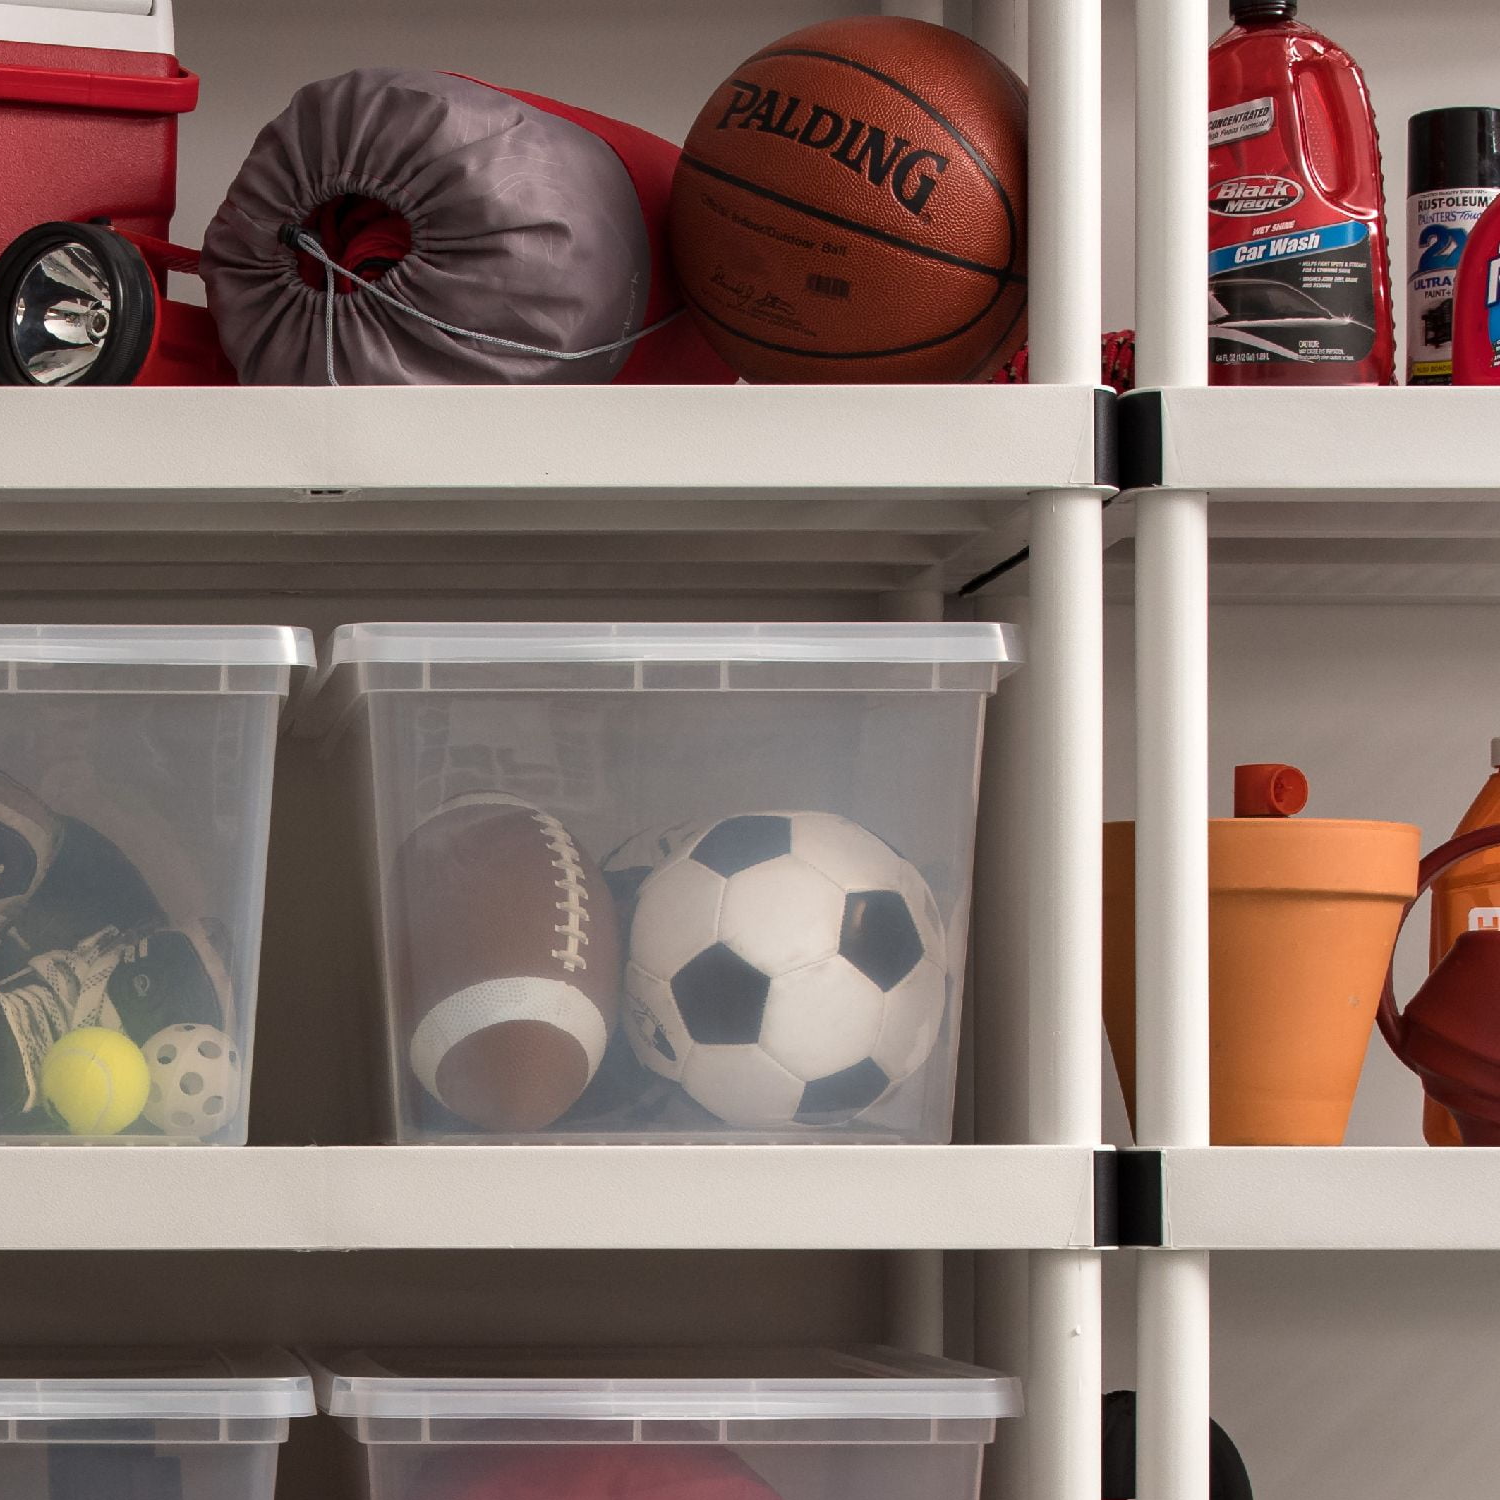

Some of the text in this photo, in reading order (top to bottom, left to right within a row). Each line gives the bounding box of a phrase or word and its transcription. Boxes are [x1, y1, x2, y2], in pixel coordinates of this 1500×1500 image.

[716, 80, 949, 217] PALDING
[1217, 181, 1292, 199] Black
[1224, 198, 1284, 213] Magic
[1418, 196, 1488, 212] RUST-OLEUM
[1252, 220, 1296, 236] WET SHINE
[1235, 233, 1320, 264] Car Wash
[1414, 276, 1451, 291] ULTRA
